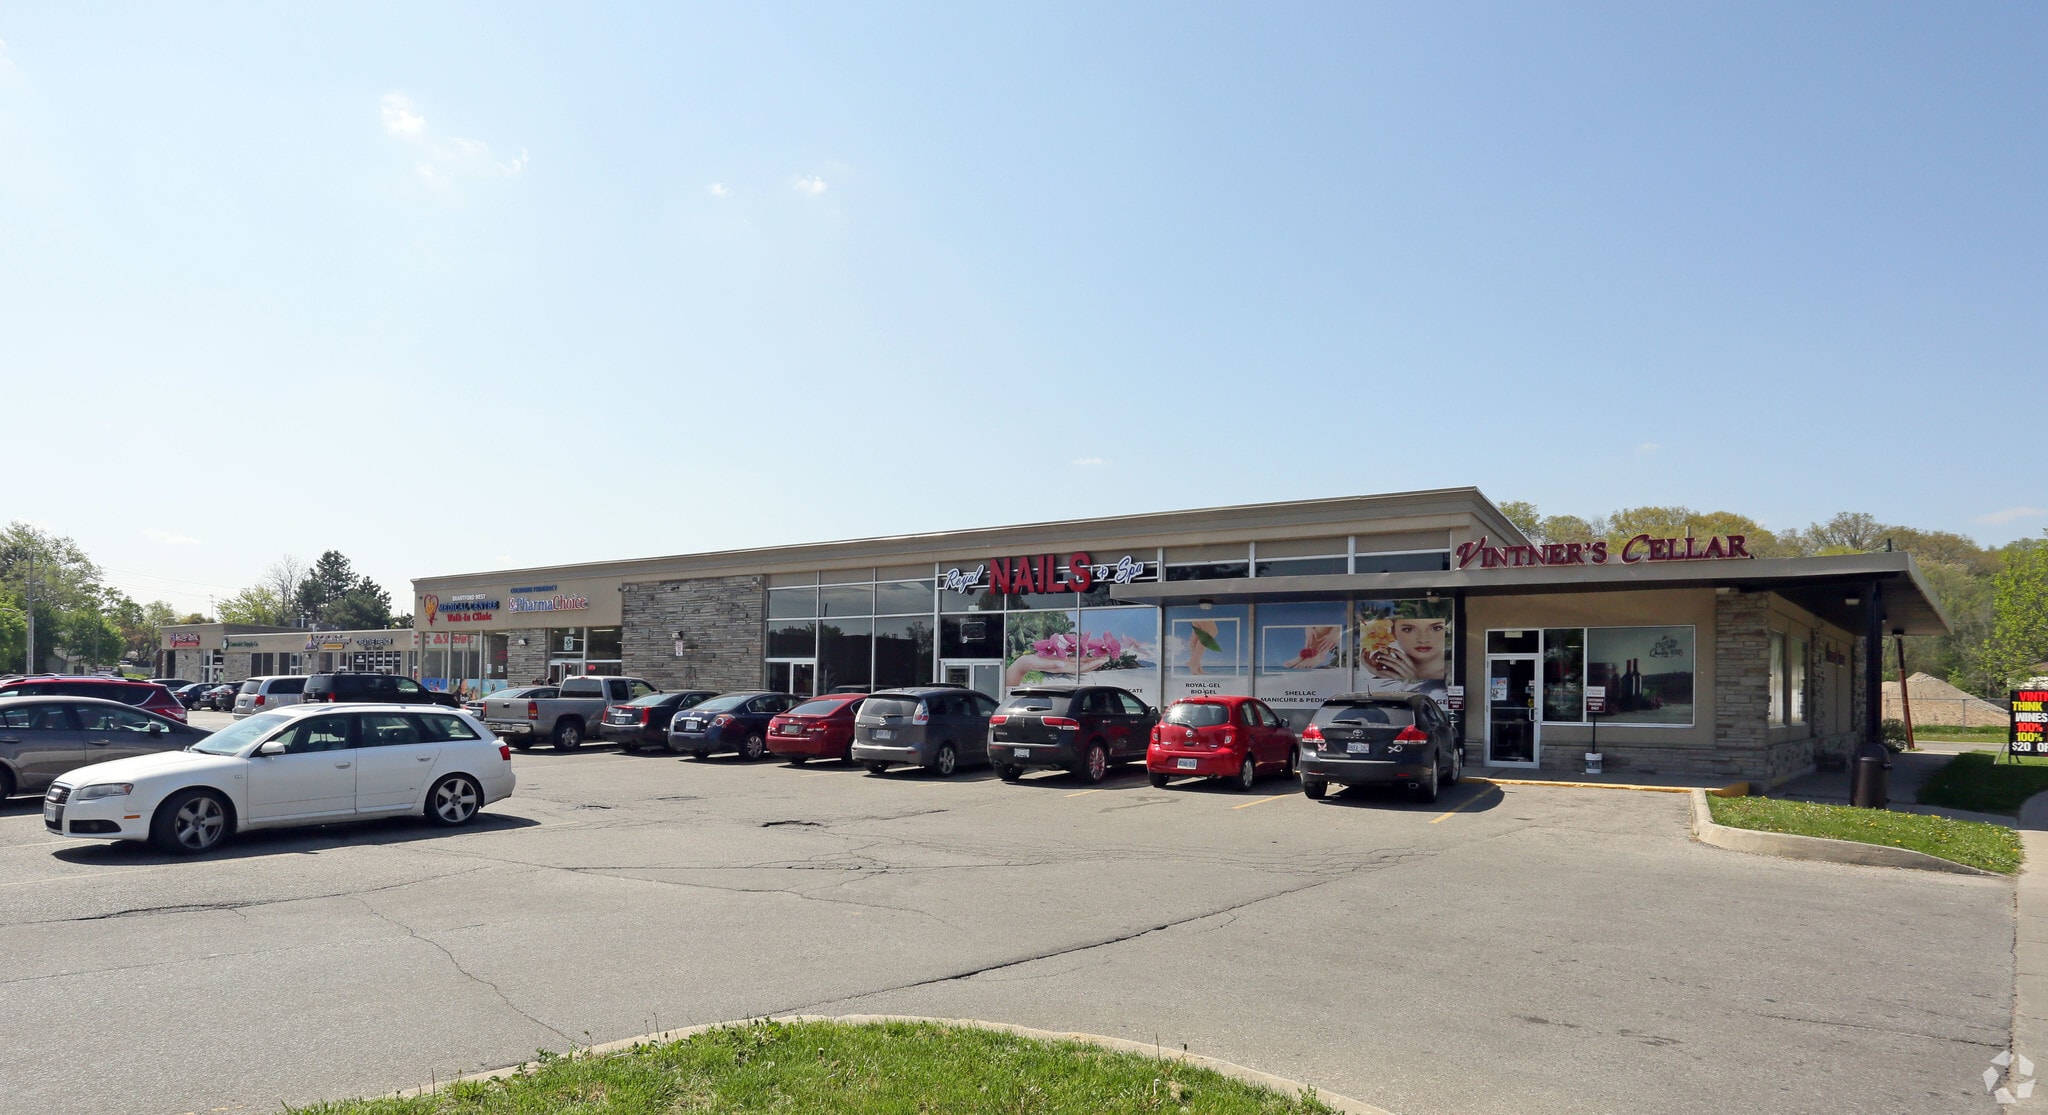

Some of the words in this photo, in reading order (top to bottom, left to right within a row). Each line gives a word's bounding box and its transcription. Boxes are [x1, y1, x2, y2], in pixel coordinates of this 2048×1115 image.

[1456, 535, 1609, 570] VINTNER'S
[1621, 533, 1751, 565] CELLAR
[943, 564, 985, 593] Royal
[988, 551, 1092, 595] NAILS
[1114, 555, 1145, 584] Spa
[439, 602, 469, 612] MEDICAL
[471, 600, 499, 610] CENTRE
[517, 593, 588, 612] PharmaChoice
[473, 612, 492, 621] Clinic
[2012, 701, 2043, 711] THINK
[2015, 712, 2048, 722] WINES
[2016, 722, 2043, 732] 100%
[2016, 732, 2043, 742] 100%
[2012, 742, 2031, 751] $20
